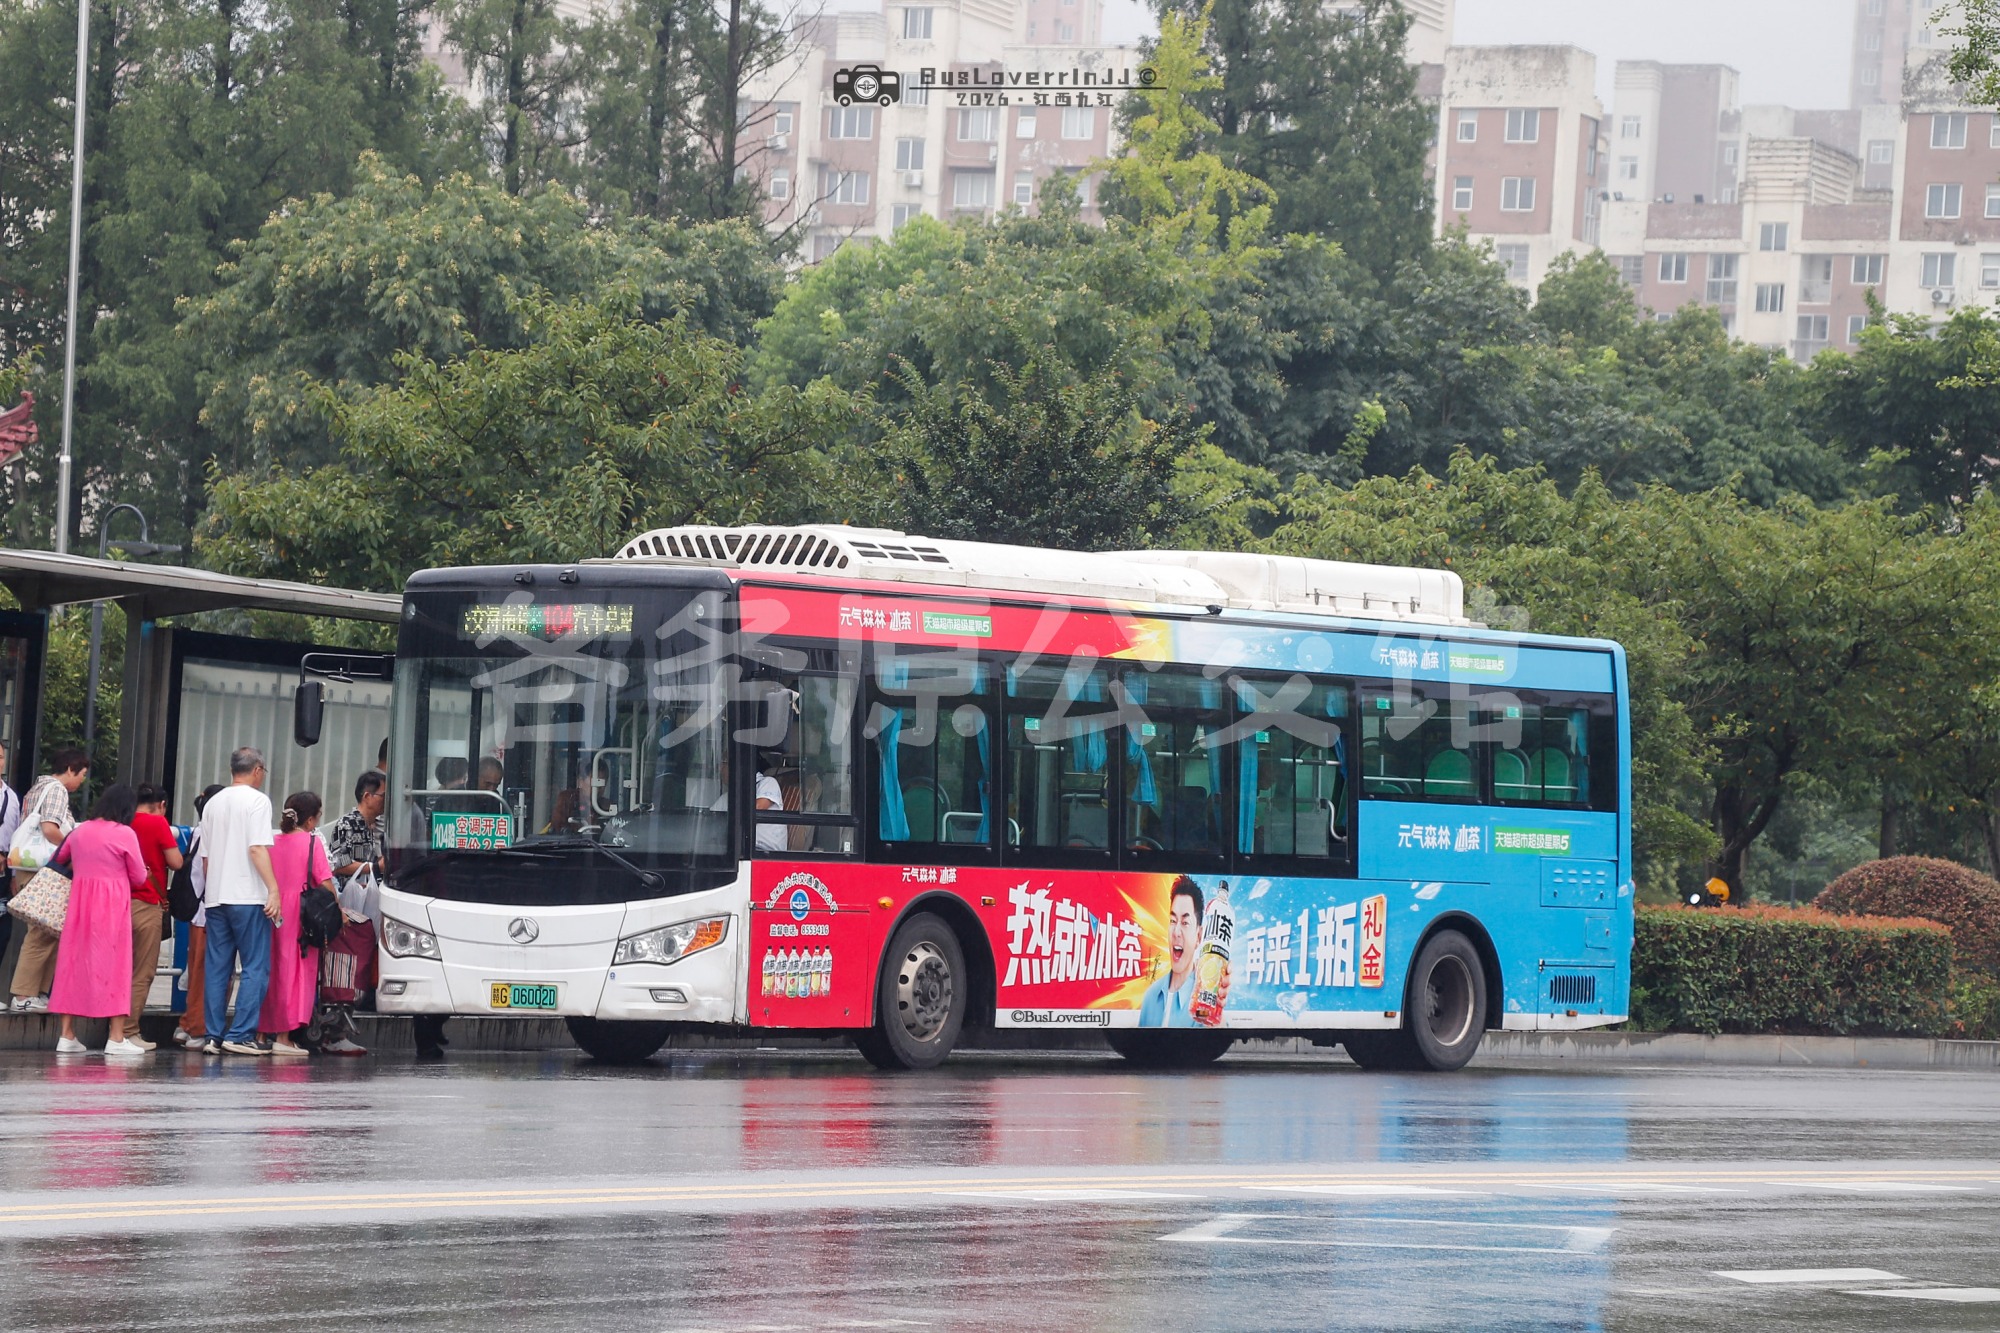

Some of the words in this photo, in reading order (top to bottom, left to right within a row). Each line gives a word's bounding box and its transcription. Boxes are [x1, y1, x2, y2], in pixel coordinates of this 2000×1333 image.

[544, 604, 573, 634] 104
[840, 606, 886, 629] 元气森林
[889, 609, 912, 631] 冰茶
[1380, 648, 1418, 669] 元气森林
[1421, 649, 1439, 670] 冰茶
[435, 823, 455, 848] 104路
[456, 816, 508, 836] 空调开启
[1398, 824, 1451, 850] 元气森林
[1454, 824, 1481, 852] 冰茶
[902, 867, 937, 883] 元气森林
[940, 866, 957, 884] 冰茶
[765, 872, 838, 915] 九江市公共交通集团公司
[1002, 881, 1143, 987] 热就冰茶
[1246, 902, 1357, 987] 再来1瓶
[1362, 902, 1383, 980] 礼金
